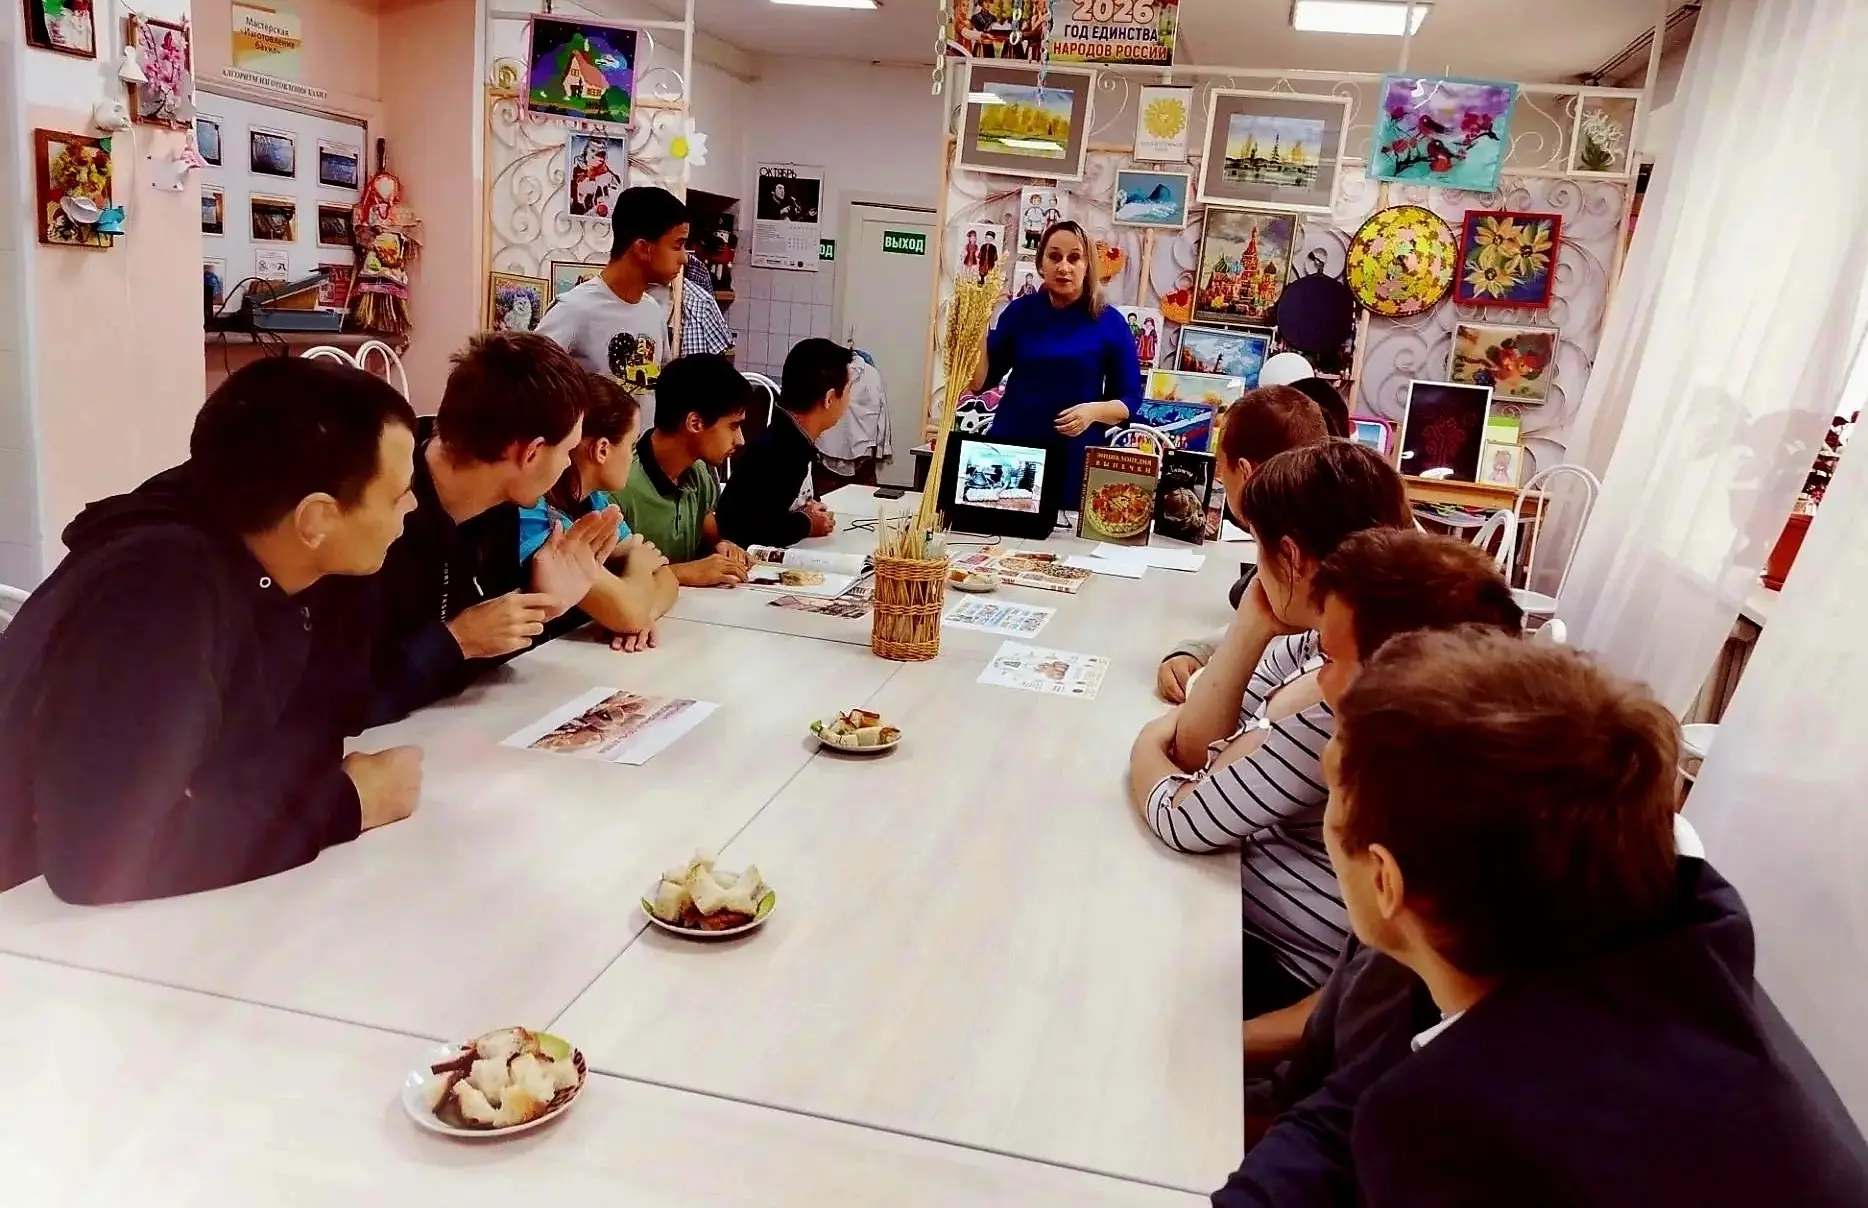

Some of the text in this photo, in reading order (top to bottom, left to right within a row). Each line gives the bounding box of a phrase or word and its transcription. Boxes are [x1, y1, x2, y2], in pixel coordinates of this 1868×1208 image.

[1072, 0, 1155, 24] 2026
[245, 16, 289, 36] Мастерская
[1064, 25, 1158, 41] ГОД ЕДИНСТВА
[1053, 42, 1168, 59] НАРОДОВ РОССИИ
[759, 167, 797, 179] ОКТЯБРЬ
[884, 235, 924, 253] ВЫХОД
